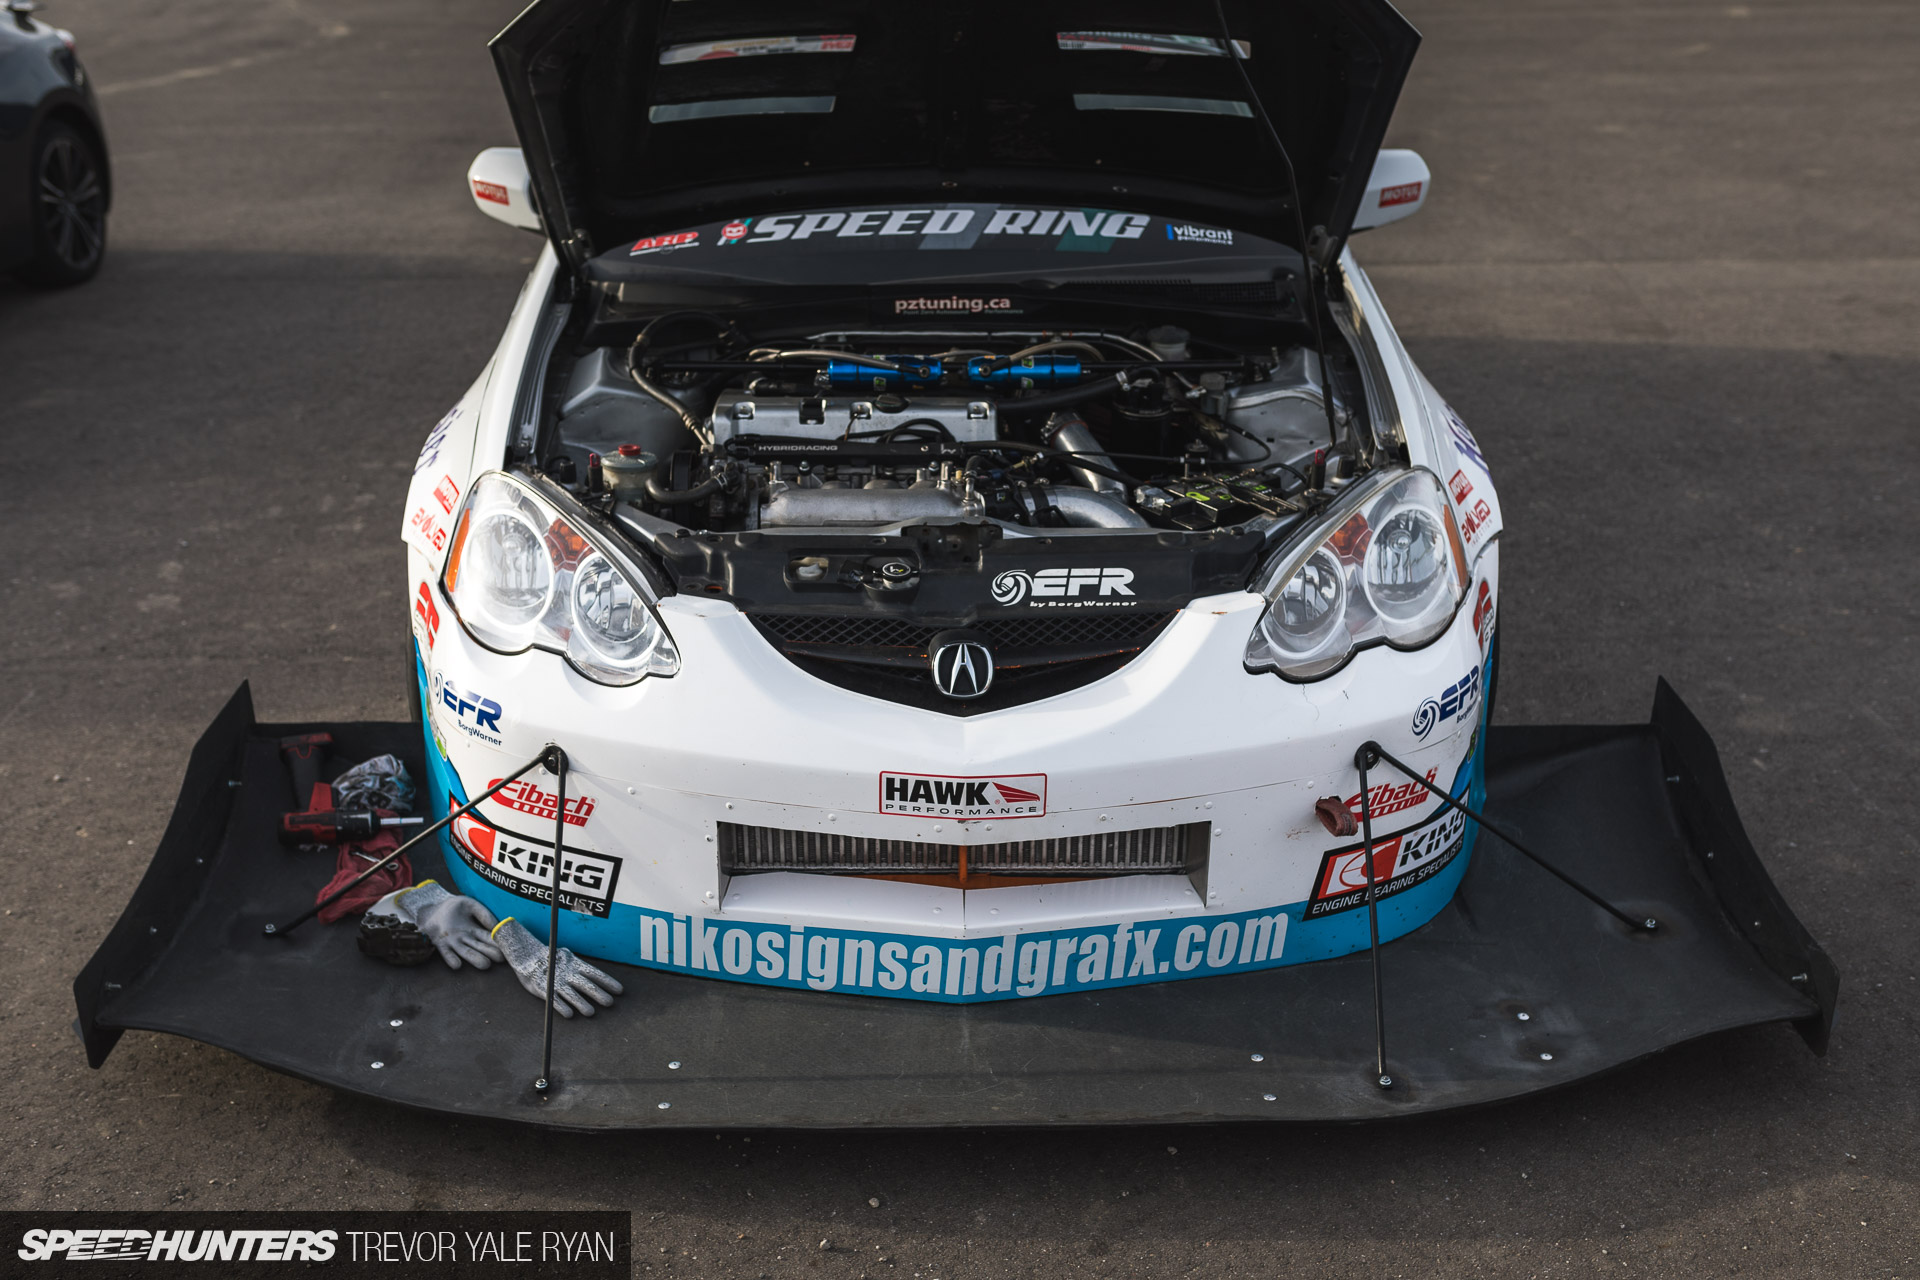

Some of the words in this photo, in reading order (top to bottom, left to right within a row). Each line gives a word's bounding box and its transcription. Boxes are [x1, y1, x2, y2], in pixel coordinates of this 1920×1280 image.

[1382, 185, 1419, 202] MOTUL
[631, 231, 699, 251] ARP
[746, 209, 976, 243] SPEED
[983, 209, 1151, 239] RING
[1173, 224, 1233, 240] vibrant
[895, 296, 1011, 314] pztuning.ca
[411, 507, 447, 551] EVOLVED
[1461, 498, 1491, 544] EVOLVED
[1031, 567, 1136, 596] EFR
[1048, 600, 1138, 608] BorgWarner
[443, 680, 502, 734] EFR
[1438, 664, 1479, 722] EFR
[458, 719, 503, 746] BorgWarner
[487, 778, 595, 824] Eibach
[885, 777, 991, 806] HAWK
[1343, 767, 1438, 821] Eibach
[885, 804, 1037, 816] PERFORMANCE
[497, 840, 606, 891] KING
[473, 859, 518, 890] BEARING
[520, 882, 606, 913] SPECALISTS
[1312, 892, 1363, 915] ENGINE
[639, 911, 1288, 996] nikosignsandgrafx.com
